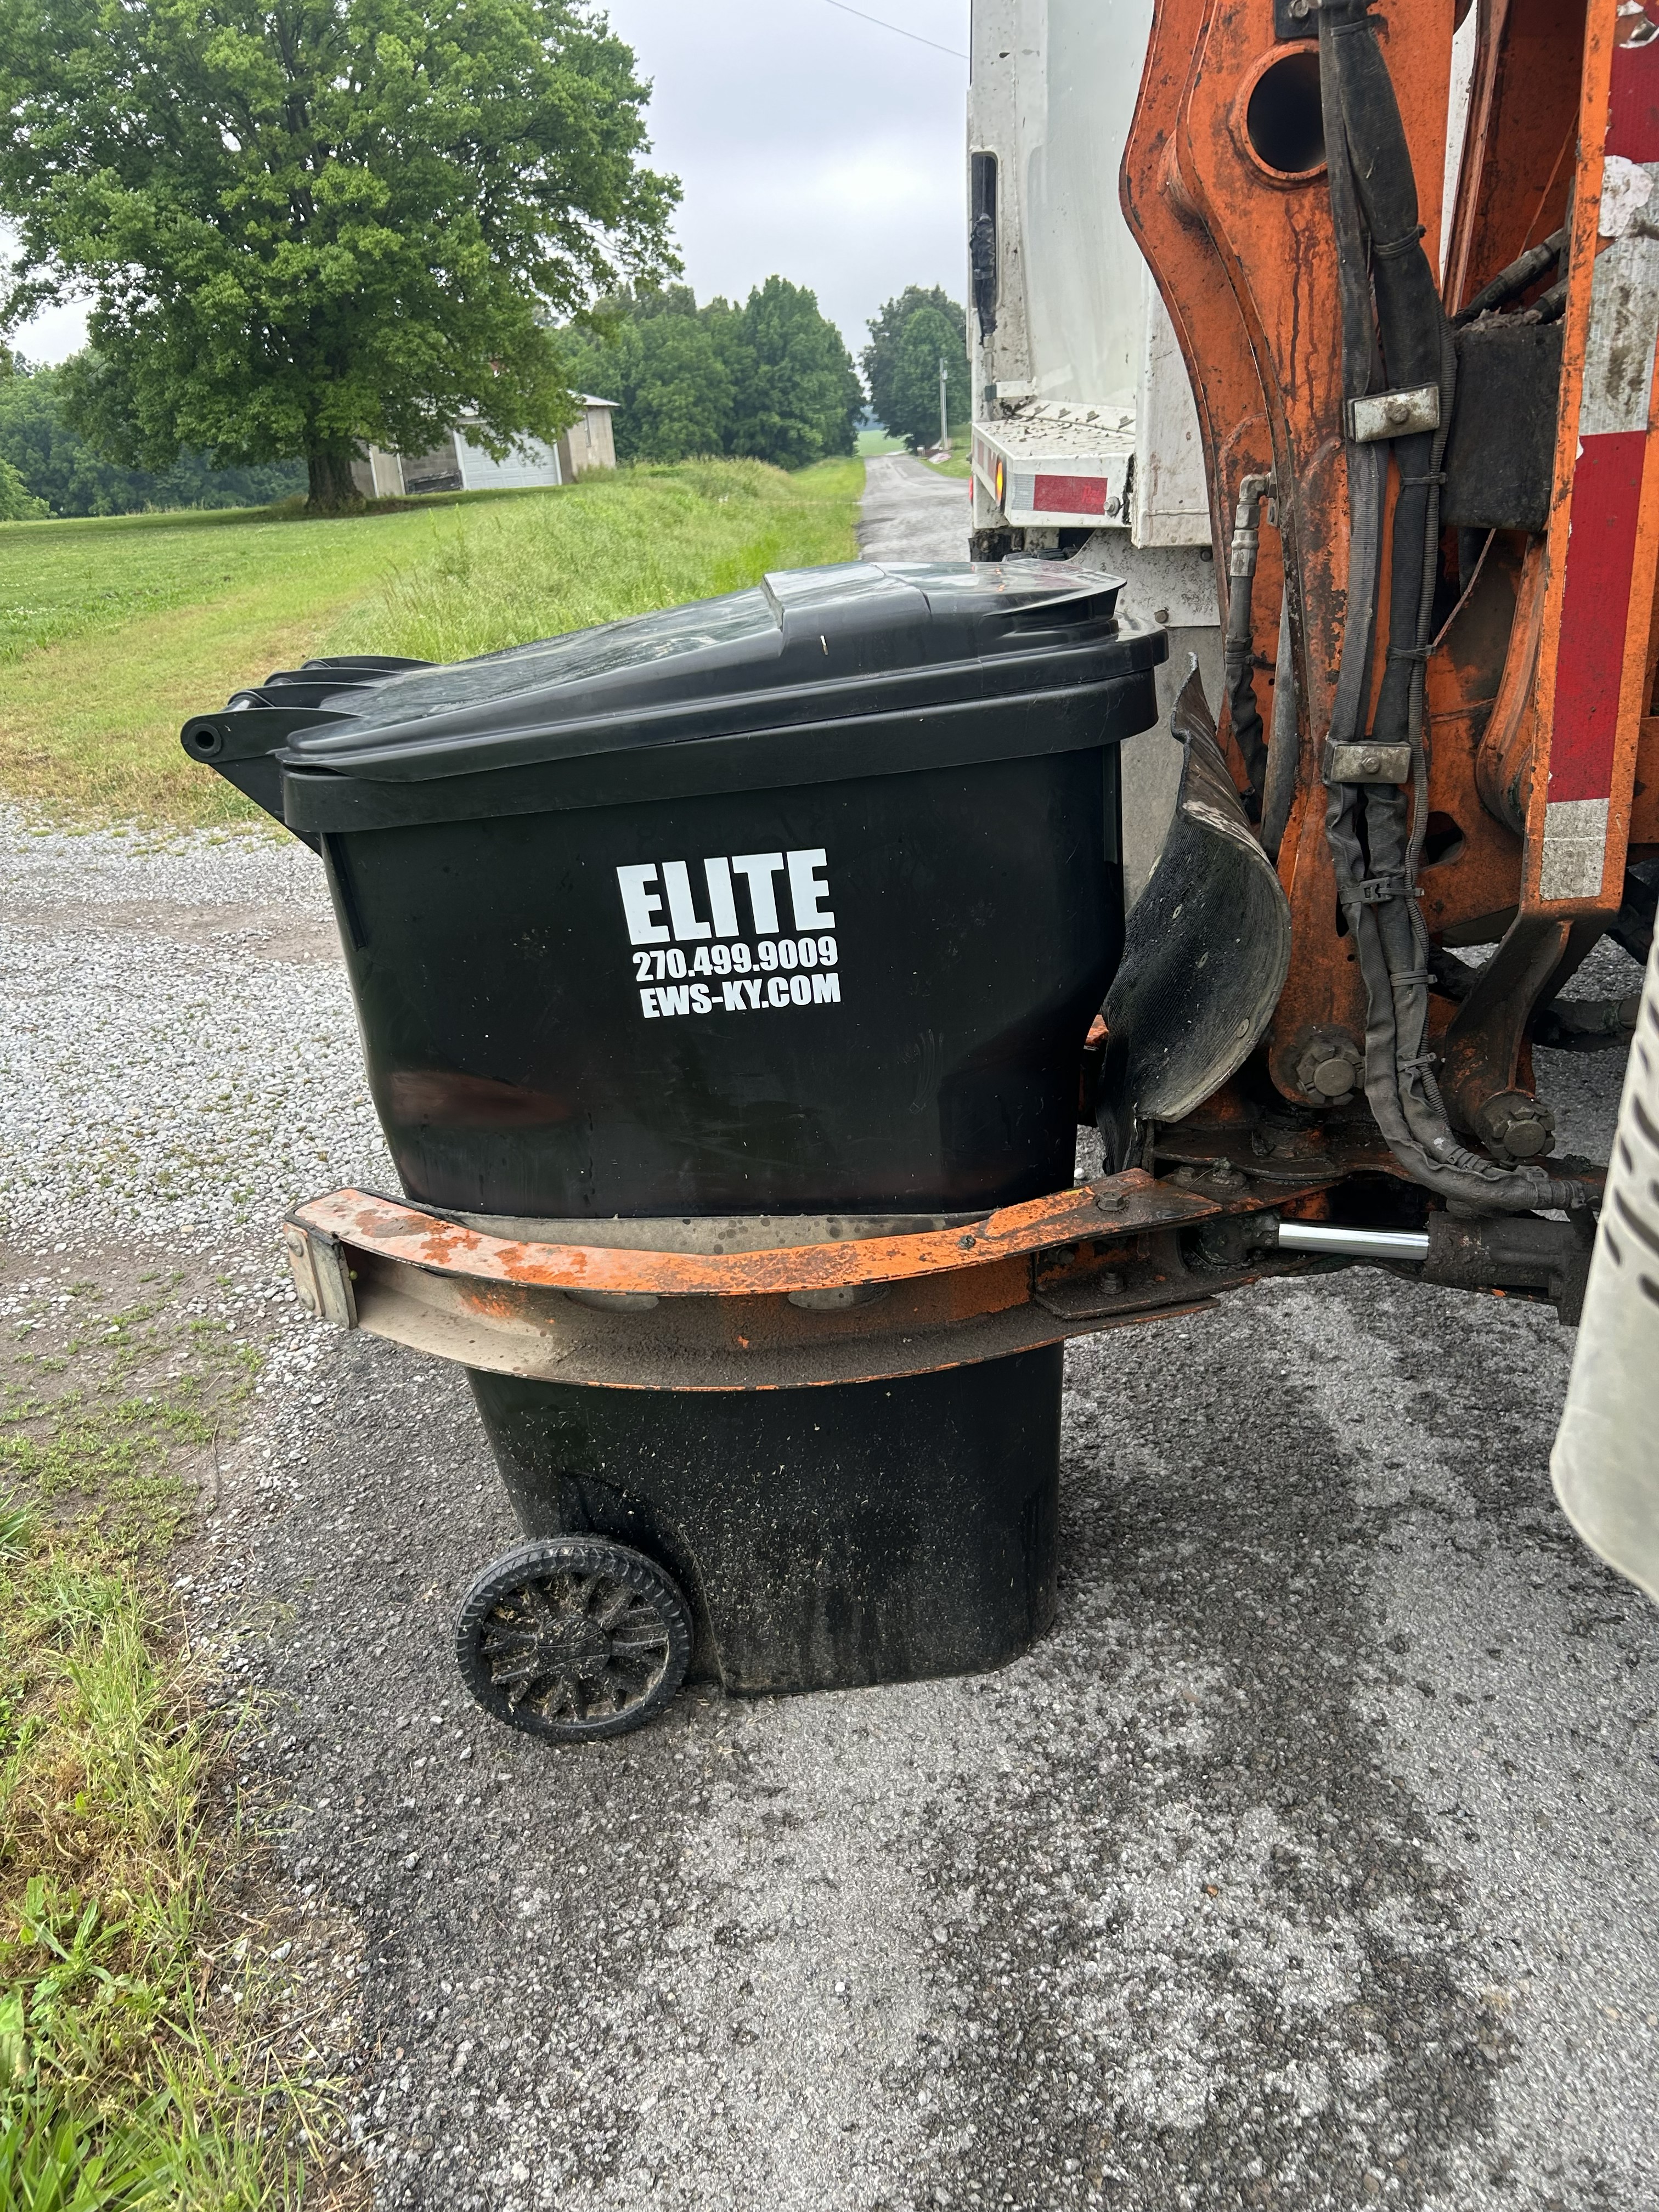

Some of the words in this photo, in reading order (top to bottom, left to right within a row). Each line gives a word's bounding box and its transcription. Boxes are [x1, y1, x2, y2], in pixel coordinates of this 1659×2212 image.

[616, 848, 836, 945] ELITE
[633, 936, 838, 981] 270.499.9009
[640, 973, 841, 1018] EWS-KY.COM
